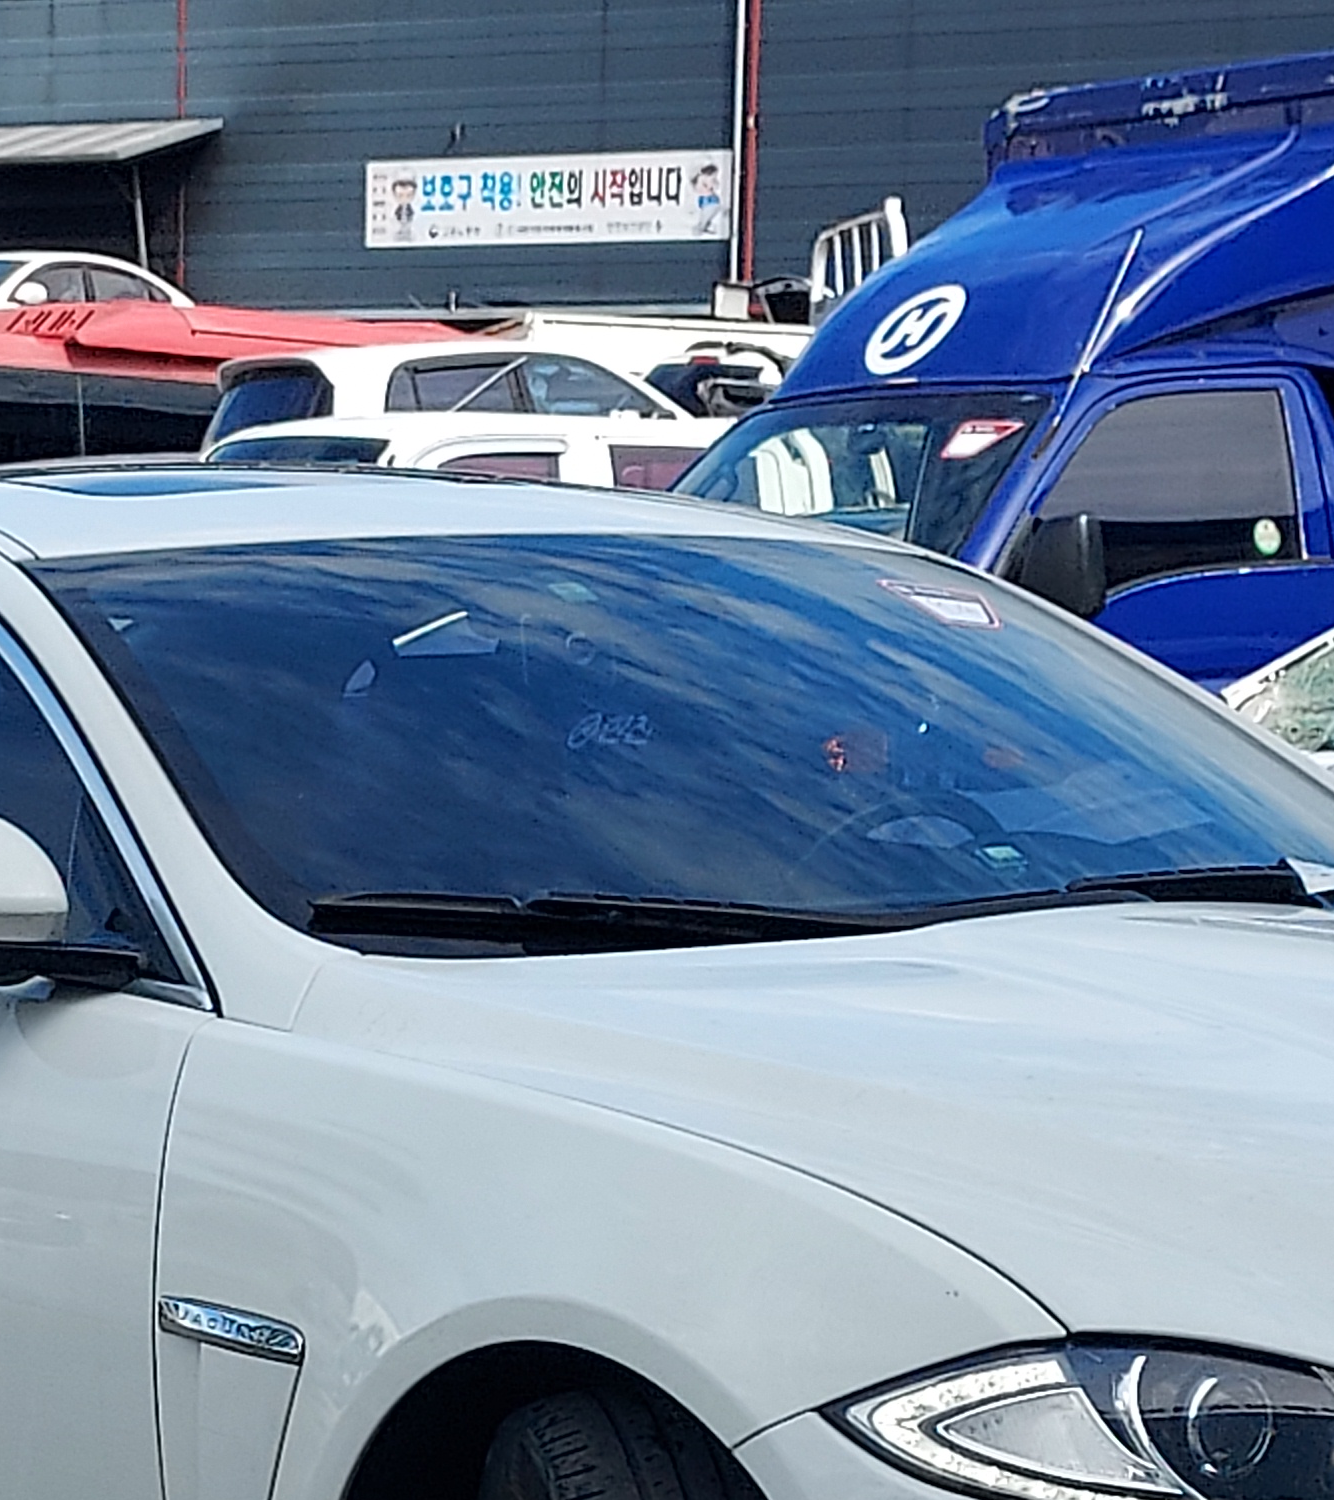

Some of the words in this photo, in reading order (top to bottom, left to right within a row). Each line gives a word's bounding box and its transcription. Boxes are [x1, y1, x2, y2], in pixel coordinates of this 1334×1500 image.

[420, 174, 472, 213] 보호구
[480, 170, 522, 211] 착용!
[530, 169, 582, 209] 안전의
[591, 166, 682, 207] 시작입니다
